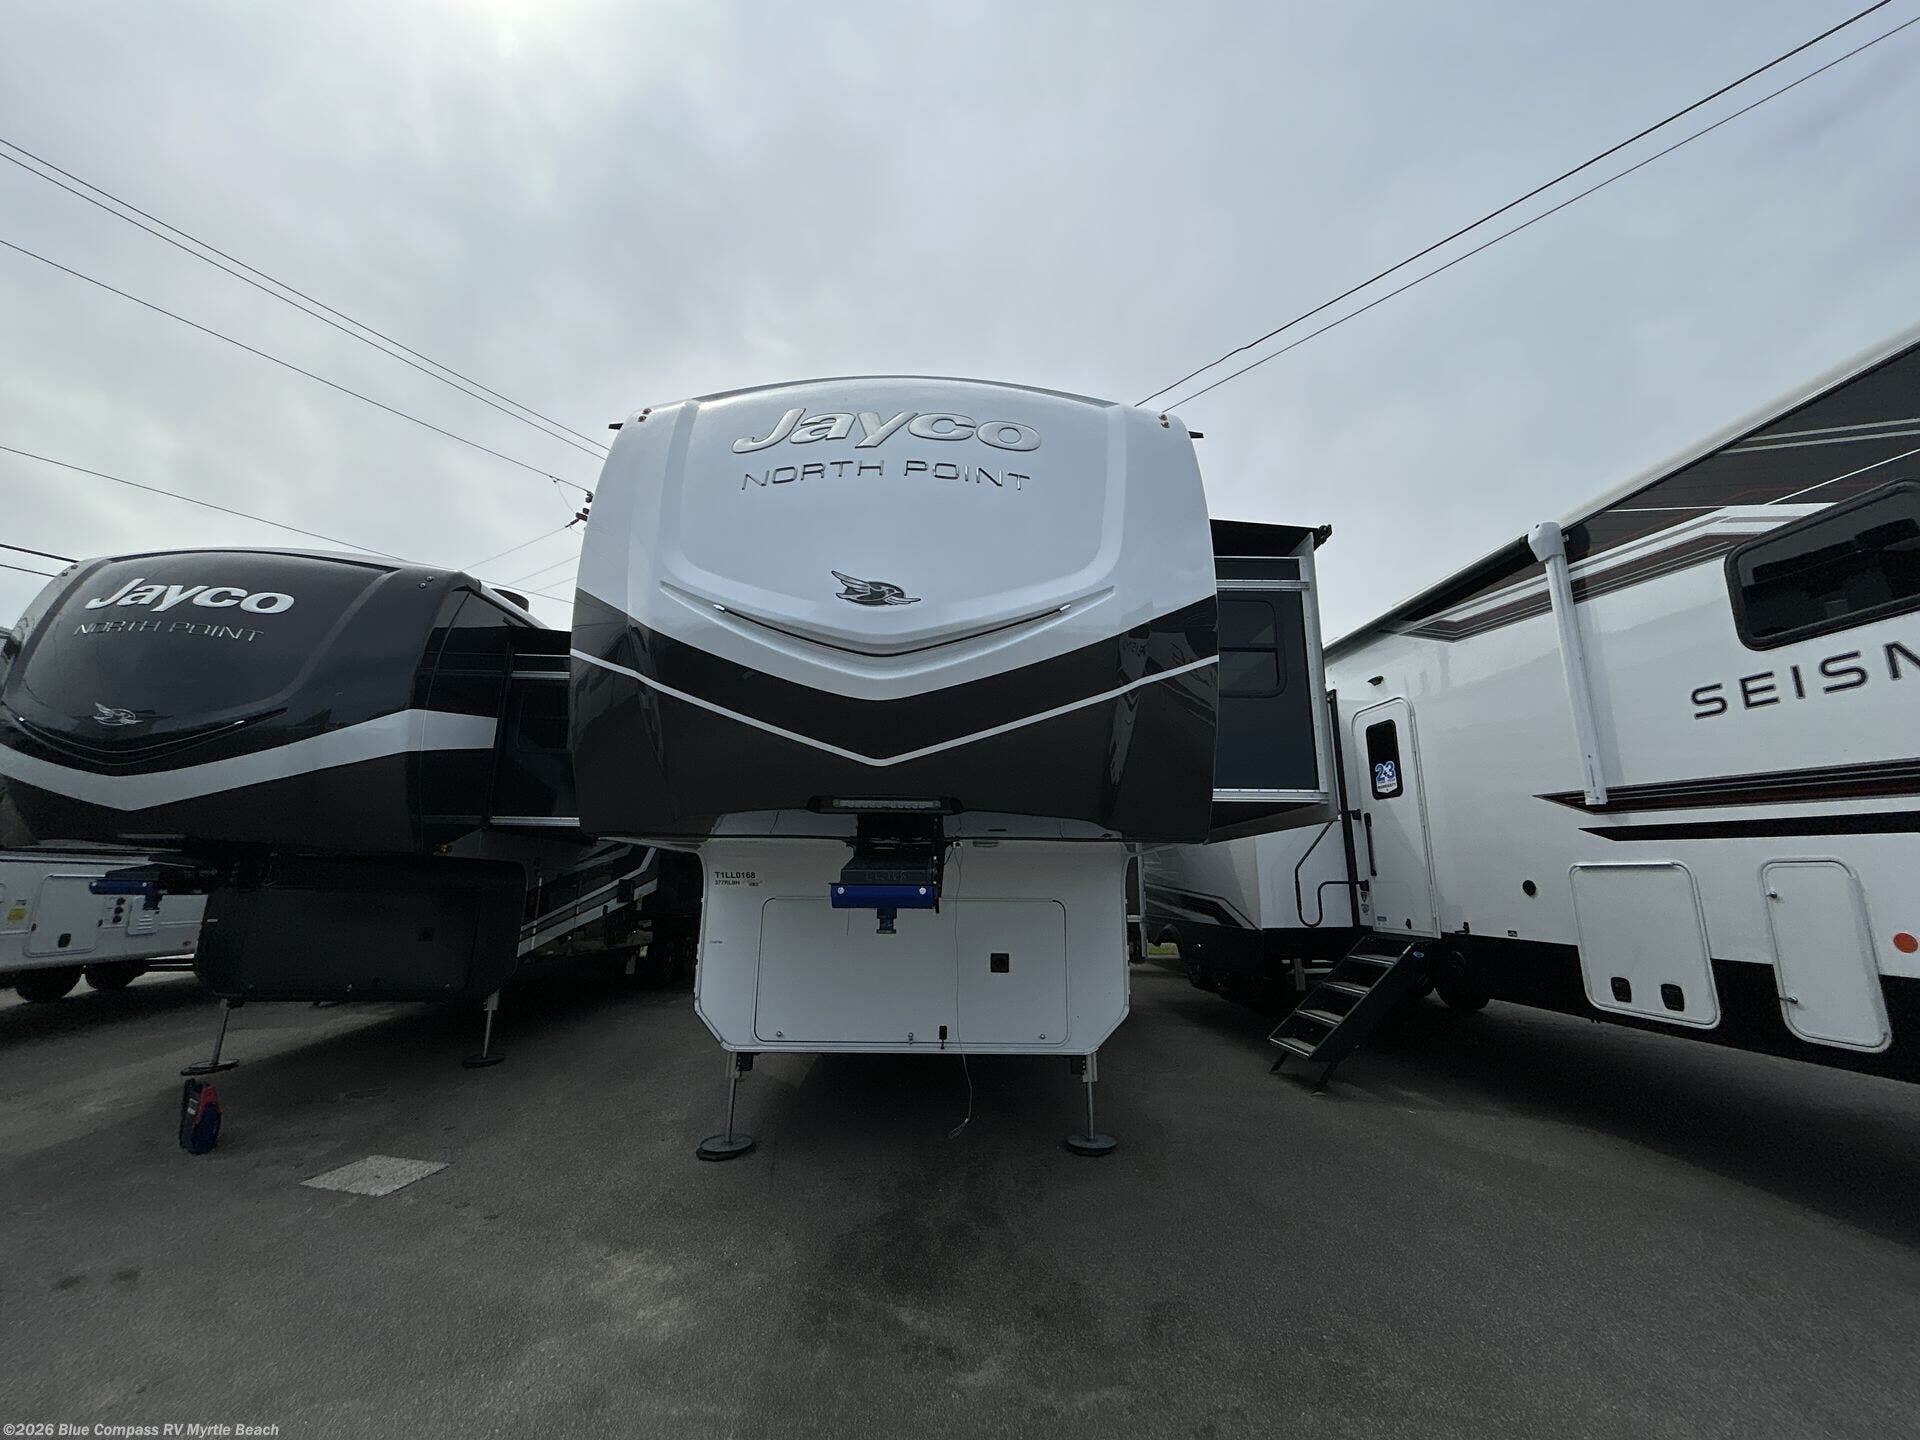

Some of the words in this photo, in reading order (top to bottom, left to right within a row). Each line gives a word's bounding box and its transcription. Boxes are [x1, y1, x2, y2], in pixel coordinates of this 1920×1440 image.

[731, 407, 1042, 454] Jayco
[741, 460, 885, 490] NORTH
[904, 460, 1030, 491] POINT
[84, 578, 296, 614] Jayco
[73, 620, 162, 636] NORTH
[168, 621, 264, 642] POINT
[714, 871, 756, 879] T1LL0168
